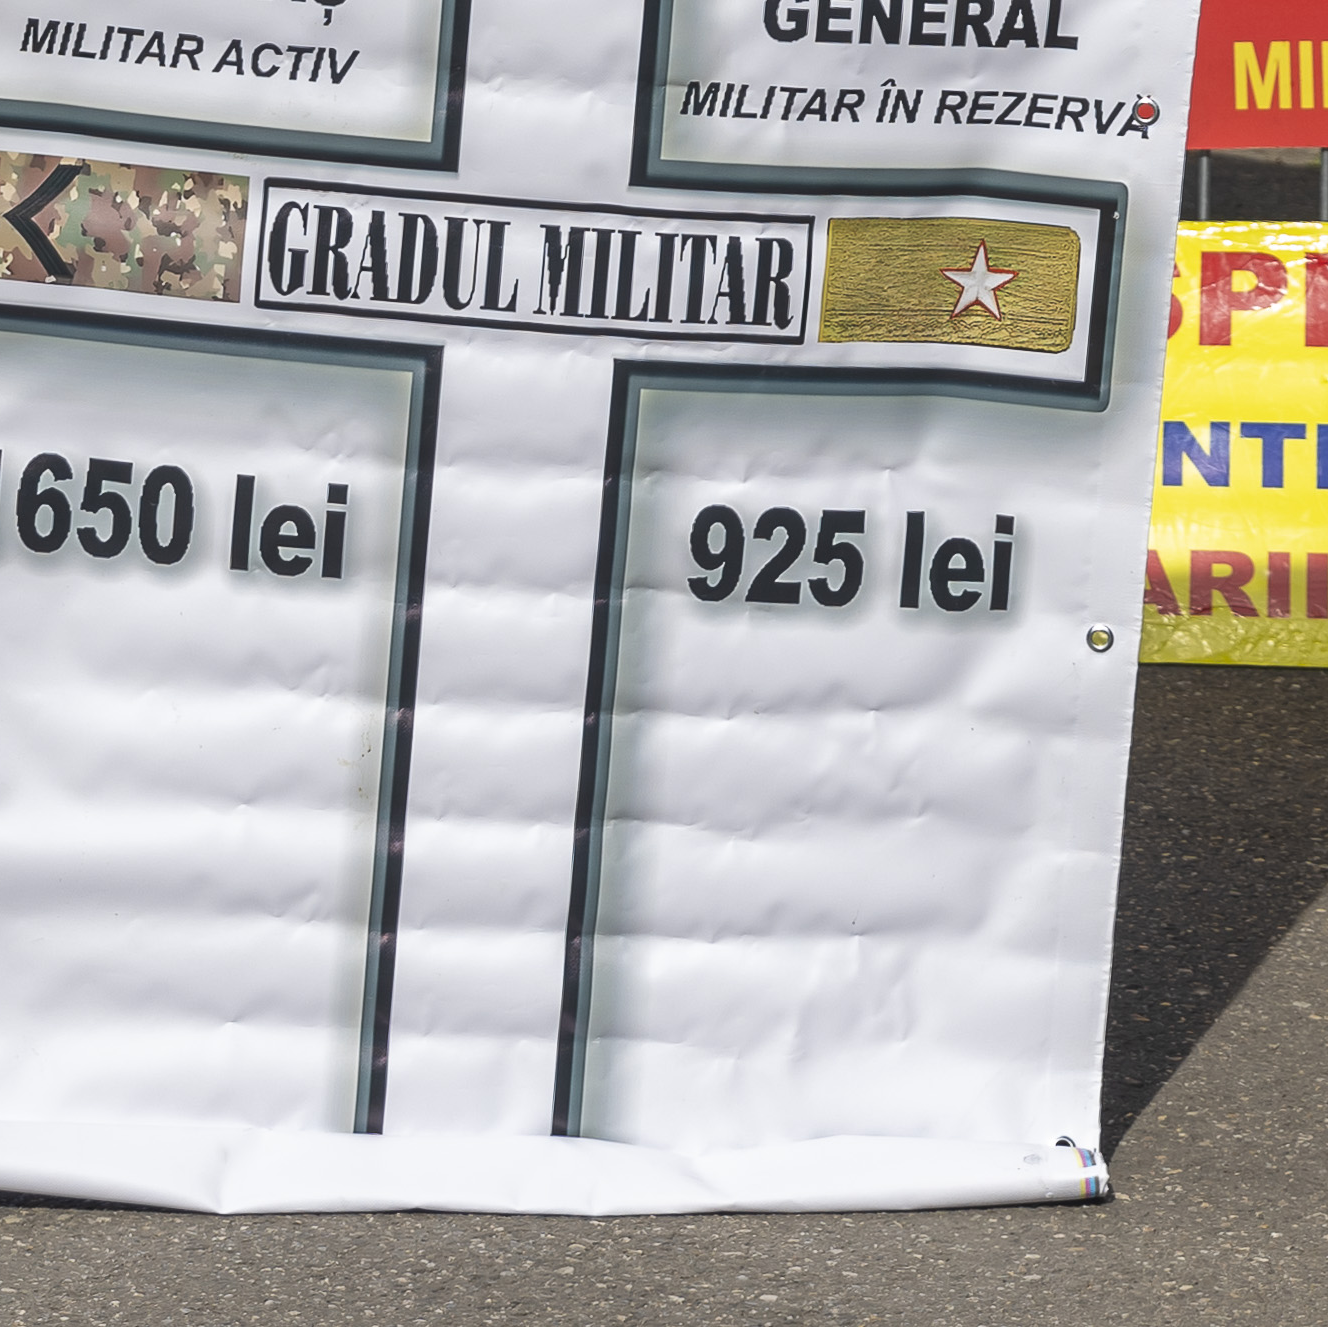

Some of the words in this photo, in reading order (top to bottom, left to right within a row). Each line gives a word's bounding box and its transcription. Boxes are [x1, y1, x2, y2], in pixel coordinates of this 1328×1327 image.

[20, 18, 204, 71] MILITAR
[212, 40, 360, 84] ACTIV
[680, 81, 865, 123] MILITAR
[875, 79, 923, 124] ÎN
[267, 201, 519, 311] GRADUL
[532, 224, 795, 331] MILITAR
[229, 474, 350, 579] lei
[687, 504, 866, 607] 925
[899, 511, 1015, 612] lei
